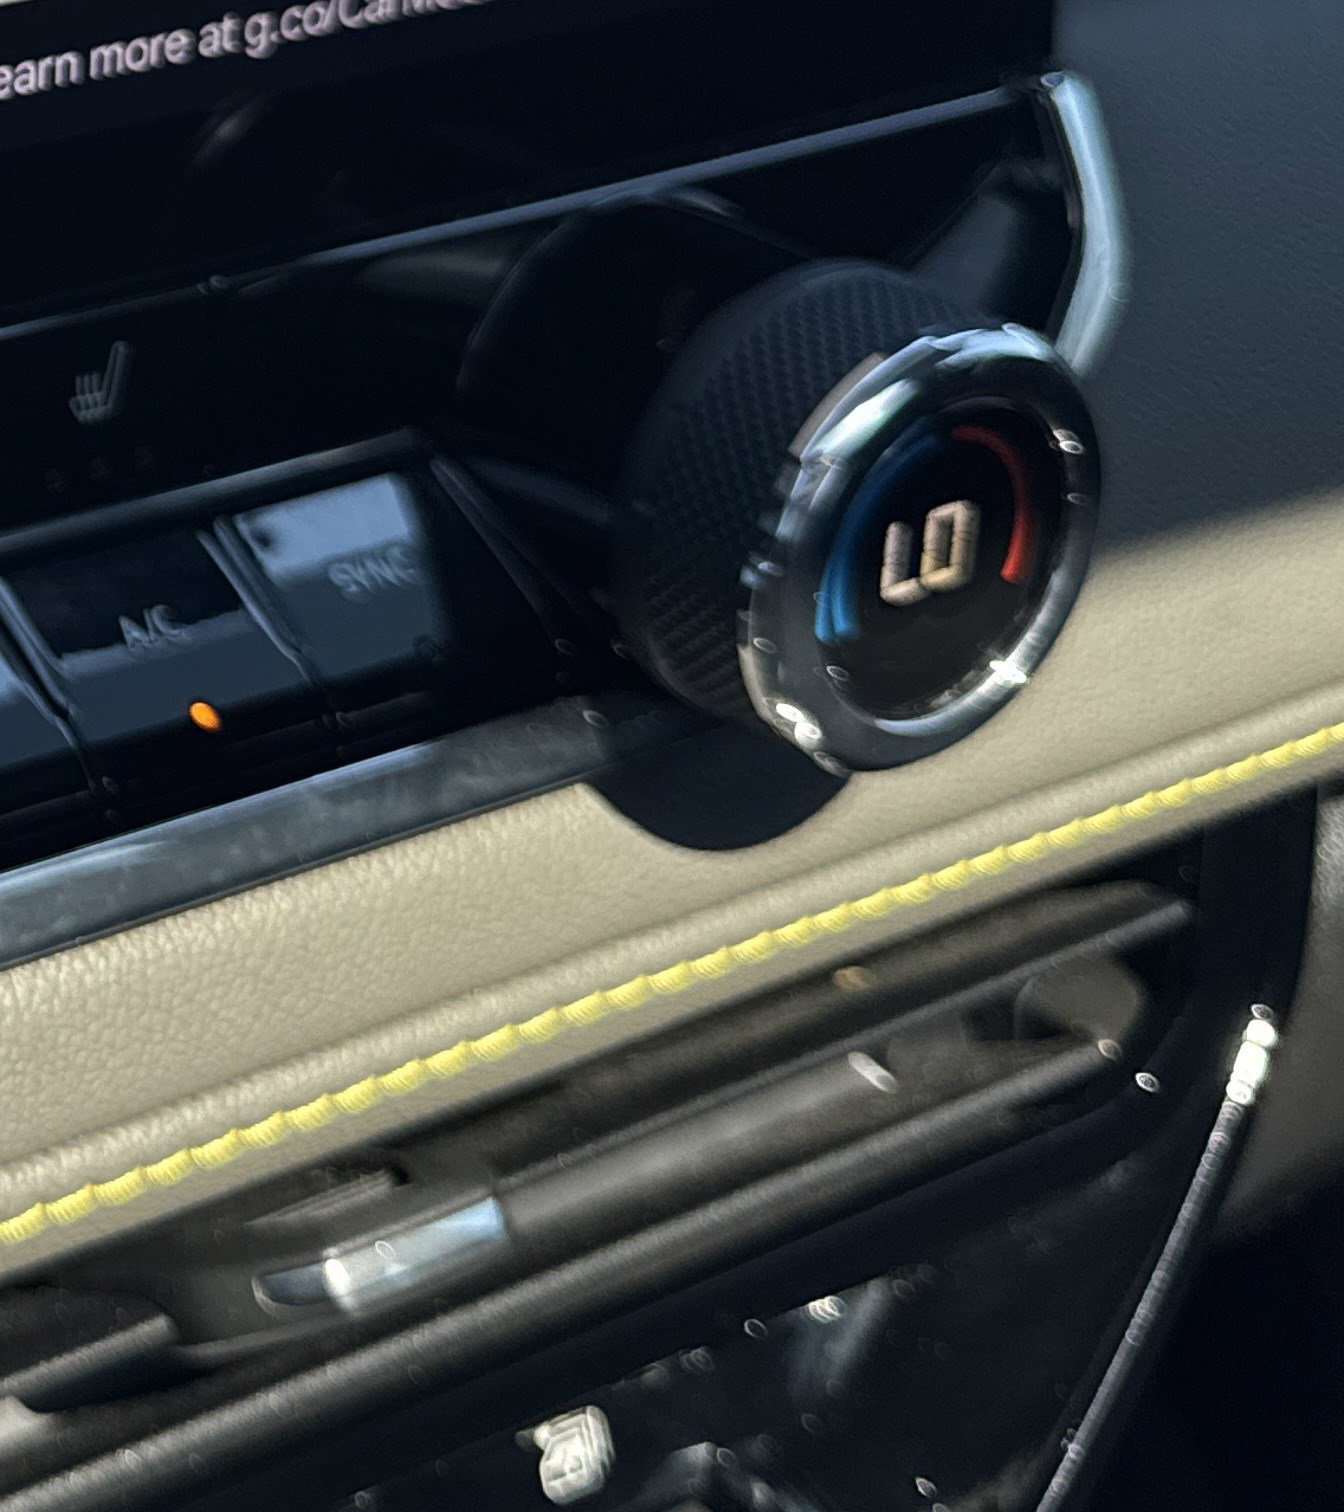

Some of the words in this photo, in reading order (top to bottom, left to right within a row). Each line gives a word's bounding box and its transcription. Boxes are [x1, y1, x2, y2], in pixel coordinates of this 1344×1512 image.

[88, 28, 193, 80] more
[196, 13, 241, 59] at
[118, 602, 184, 652] A/C
